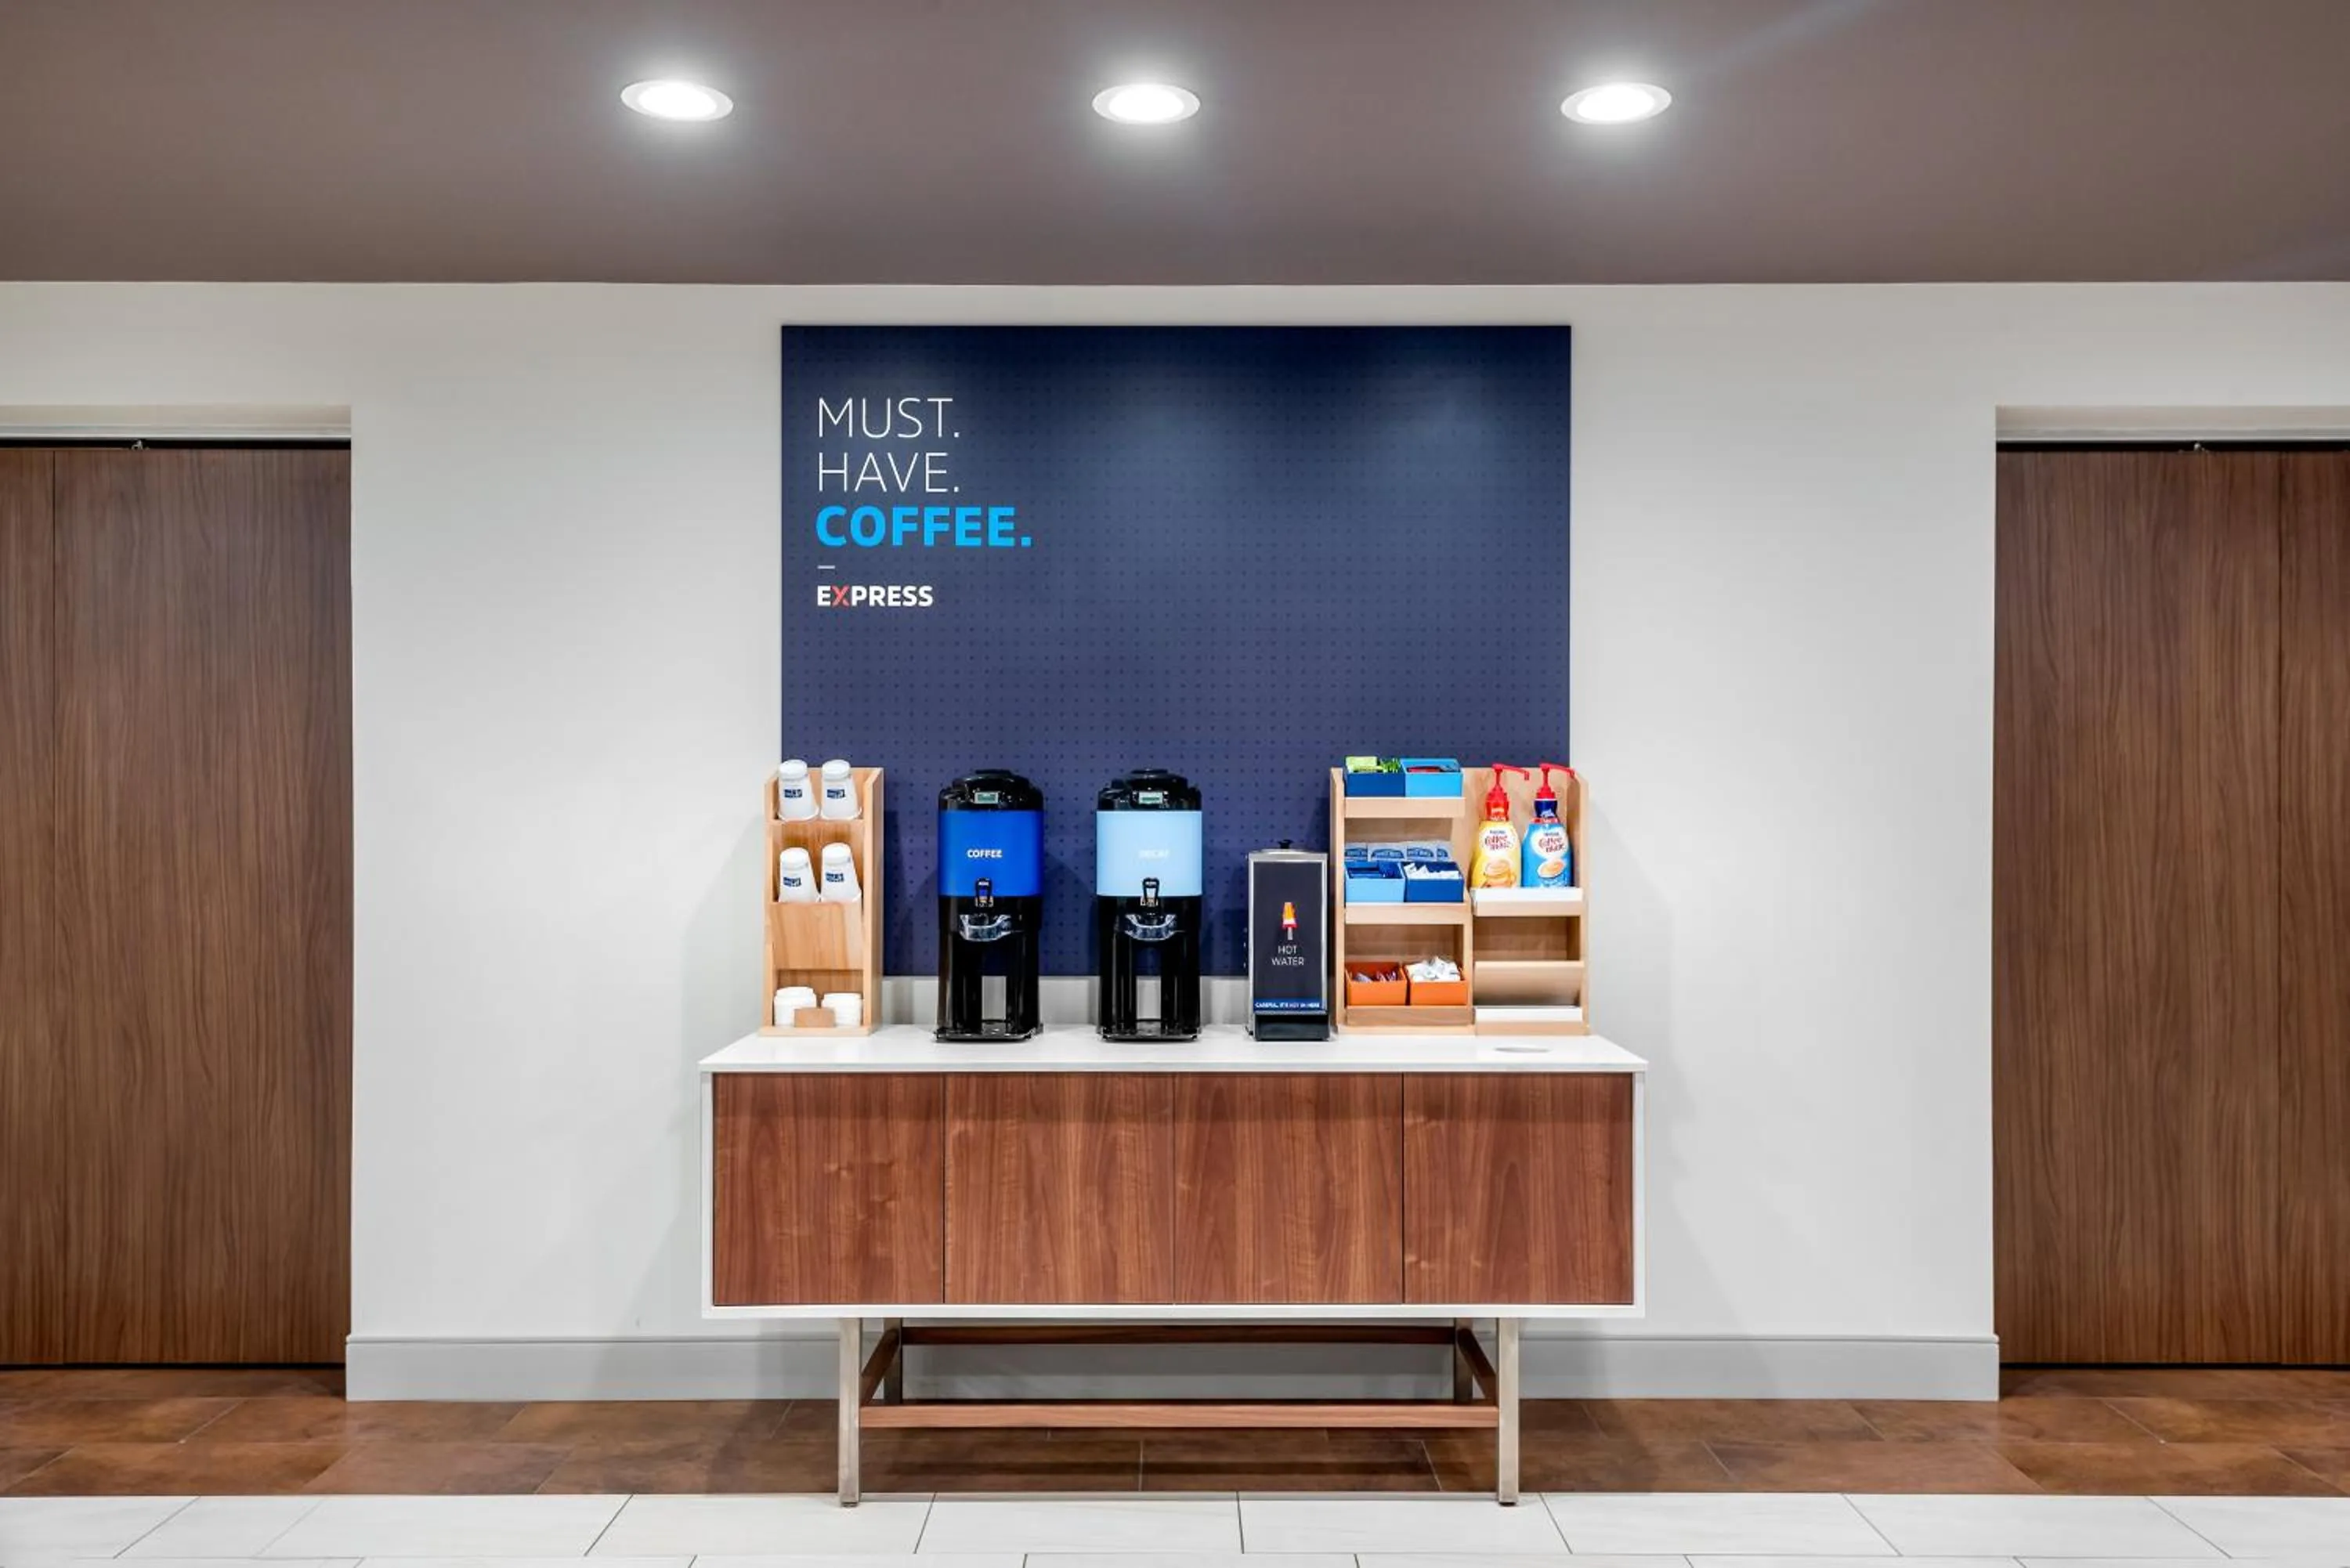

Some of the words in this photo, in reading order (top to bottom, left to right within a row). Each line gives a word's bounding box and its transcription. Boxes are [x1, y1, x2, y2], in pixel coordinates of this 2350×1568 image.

[819, 397, 960, 439] MUST.
[819, 452, 960, 493] HAVE.
[815, 505, 1032, 547] COFFEE.
[817, 585, 934, 607] EXPRESS
[967, 849, 1003, 858] COFFEE
[1271, 956, 1304, 966] WATER
[1278, 945, 1297, 955] HOT
